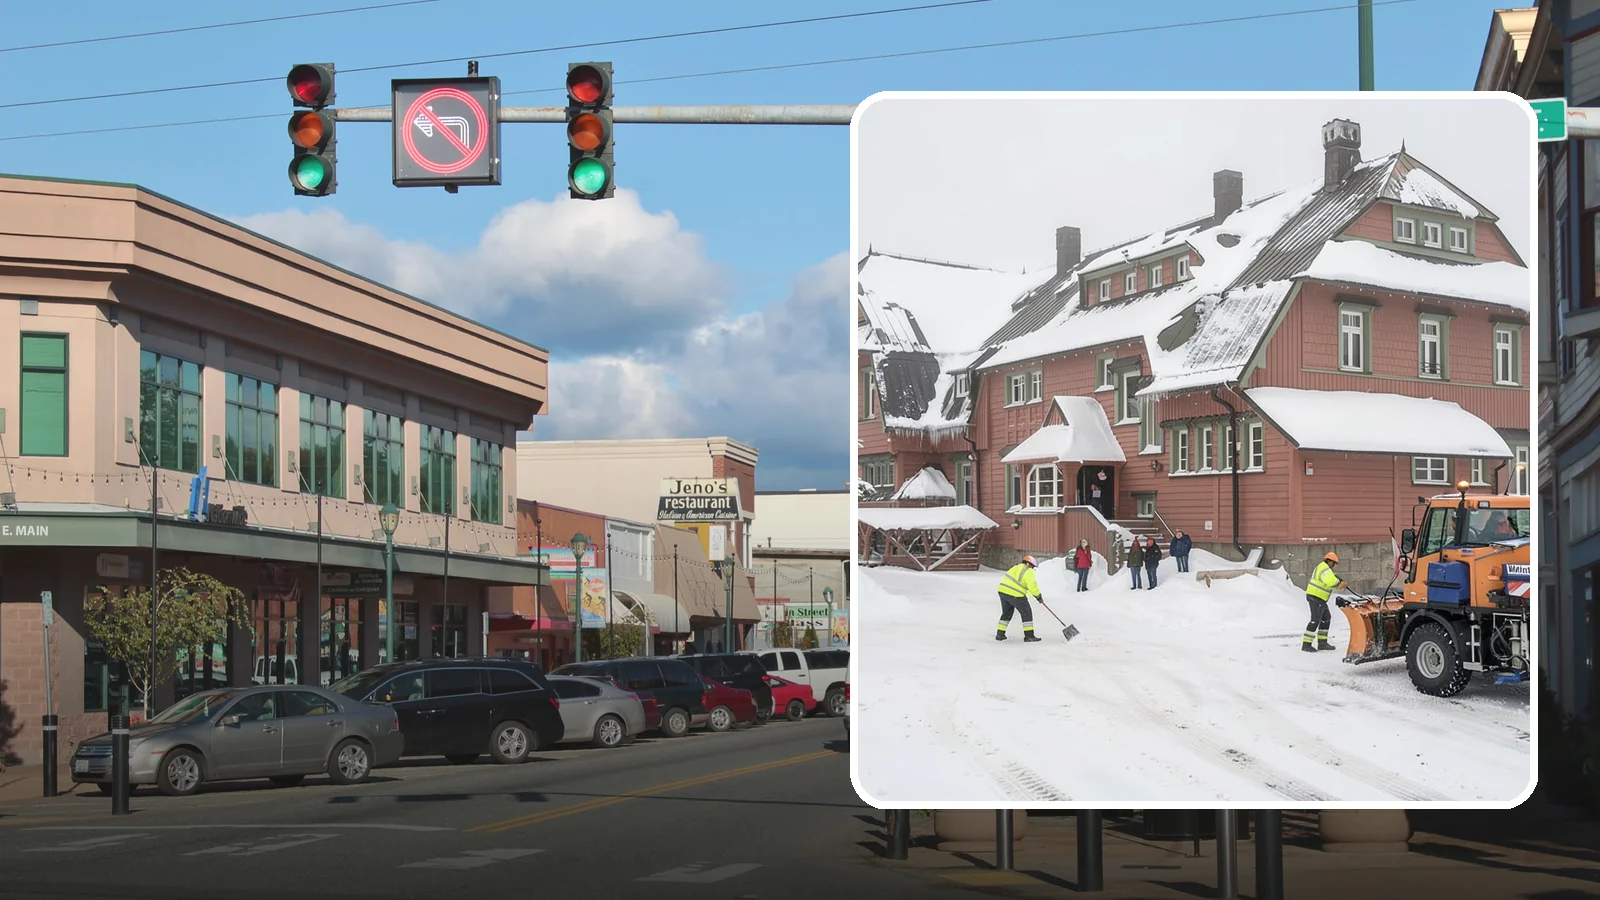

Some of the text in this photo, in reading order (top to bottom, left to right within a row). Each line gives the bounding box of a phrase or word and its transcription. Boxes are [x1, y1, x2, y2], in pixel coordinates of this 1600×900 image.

[669, 480, 727, 494] Jeno's
[665, 496, 731, 509] restaurant
[658, 510, 682, 520] Italian
[686, 510, 714, 519] American
[715, 510, 737, 519] Cuisine
[2, 525, 49, 536] E. MAIN
[797, 608, 828, 616] Street
[791, 619, 823, 627] lass
